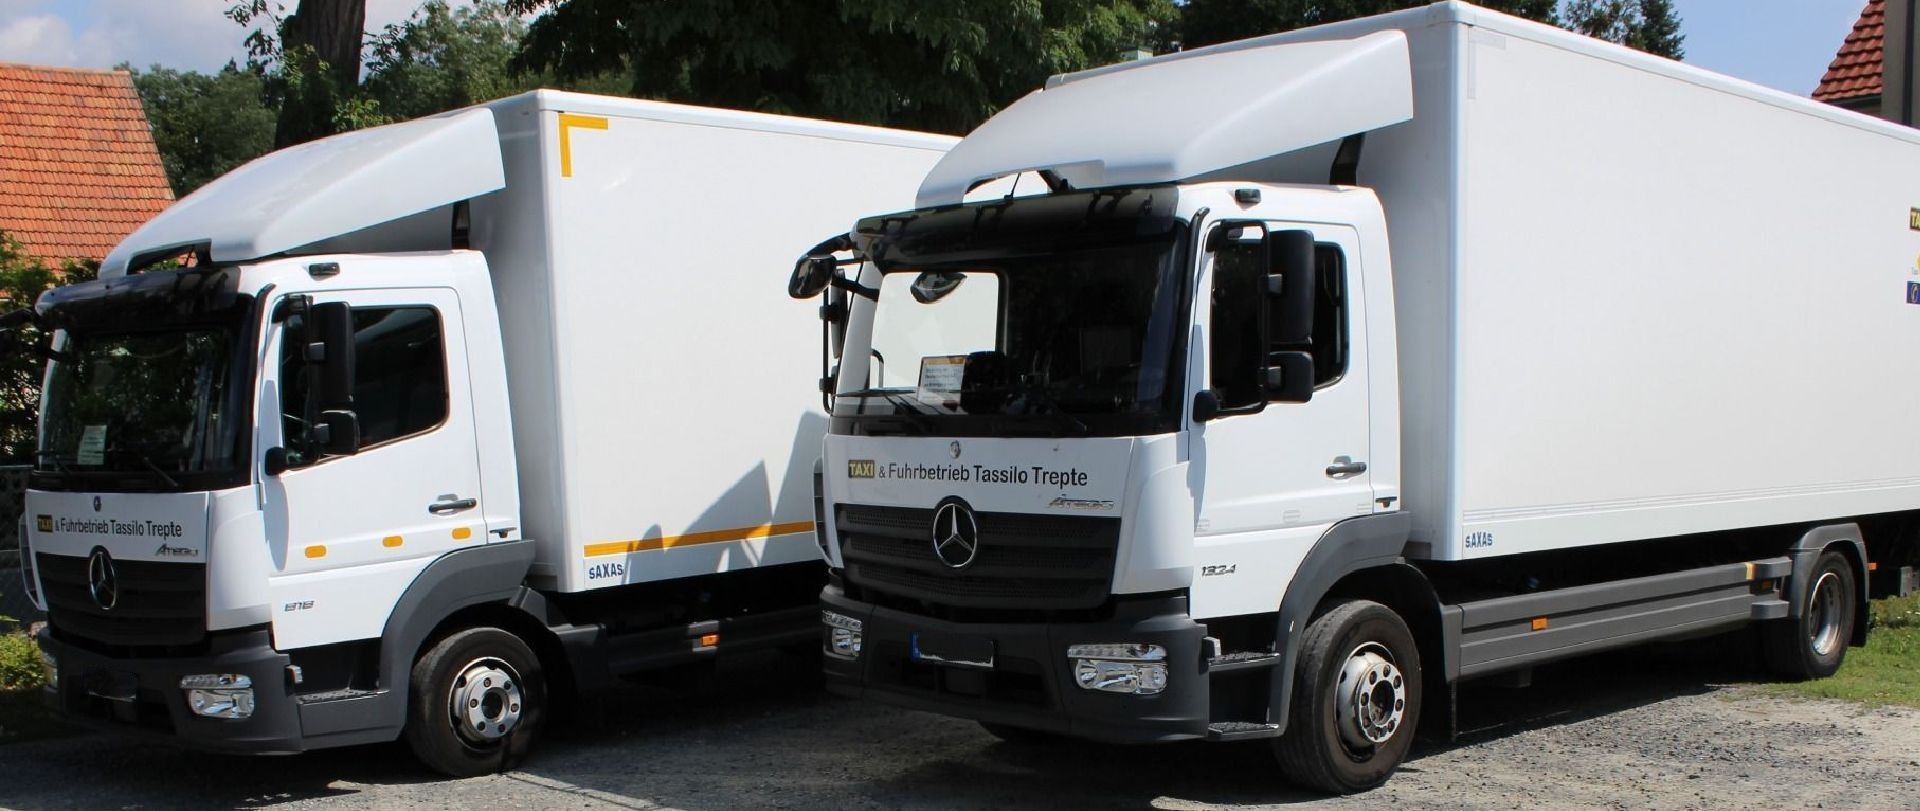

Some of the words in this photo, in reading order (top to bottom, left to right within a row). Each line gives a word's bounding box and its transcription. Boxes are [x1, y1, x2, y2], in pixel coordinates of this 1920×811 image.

[848, 462, 875, 477] TAXI
[879, 465, 886, 479] &
[888, 462, 970, 482] Fuhrbetrieb
[973, 465, 1028, 485] Tassilo
[1032, 466, 1088, 490] Trepte
[61, 518, 109, 534] Fuhrbetrieb
[110, 519, 144, 536] Tassilo
[146, 521, 182, 540] Trepte
[589, 563, 624, 580] SAXAS
